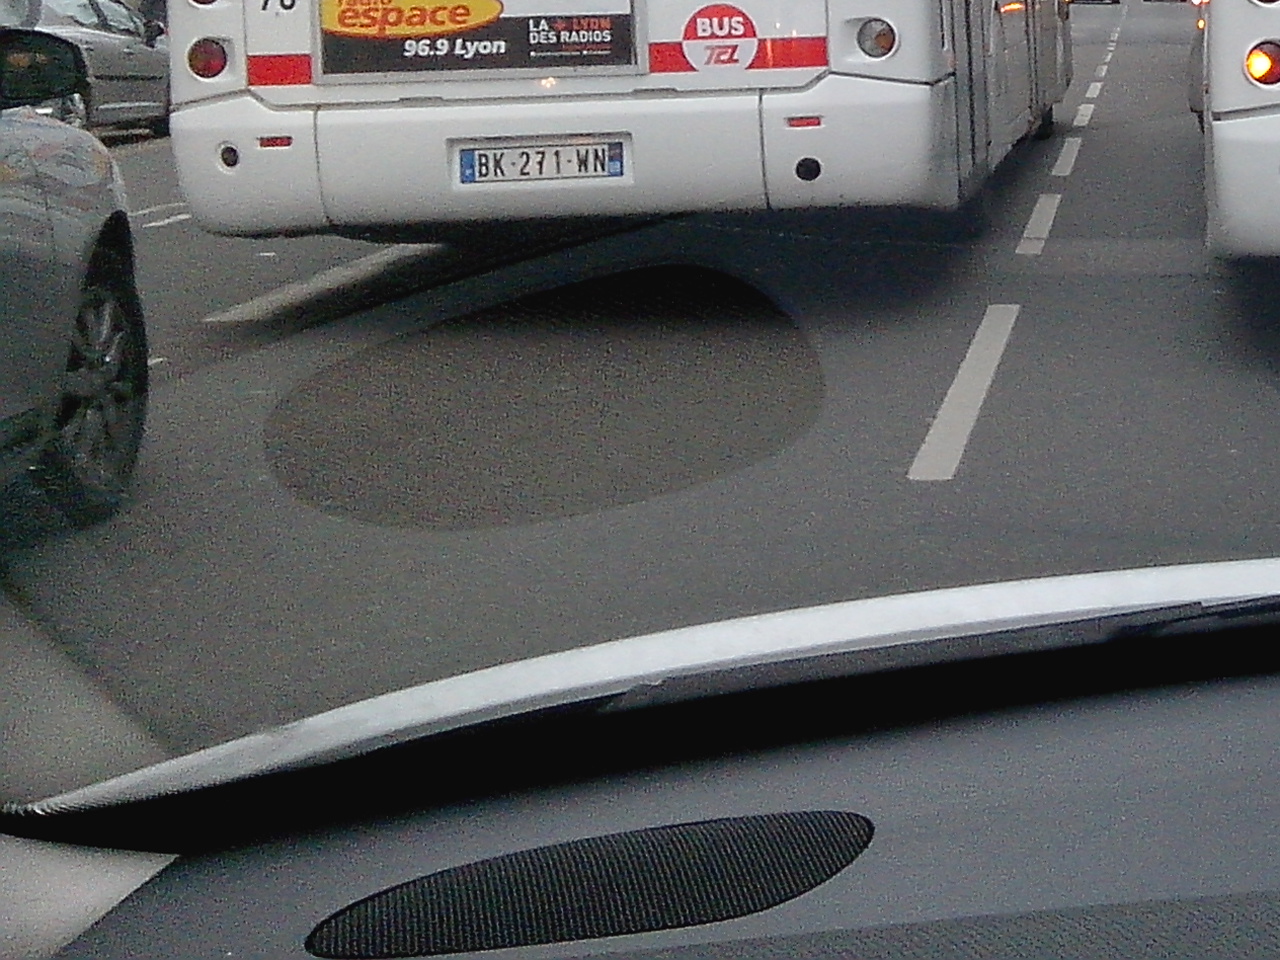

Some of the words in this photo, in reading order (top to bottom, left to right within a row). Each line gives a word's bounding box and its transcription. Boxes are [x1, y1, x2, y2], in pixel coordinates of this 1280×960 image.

[337, 3, 472, 37] espace
[528, 19, 549, 32] LA
[572, 17, 612, 30] LYON
[697, 16, 746, 37] BUS
[529, 31, 558, 44] DES
[560, 30, 612, 43] RADIOS
[402, 39, 449, 58] 96.9
[454, 38, 507, 60] Lyon
[704, 44, 740, 66] TCL
[478, 148, 606, 178] BK-271-WN
